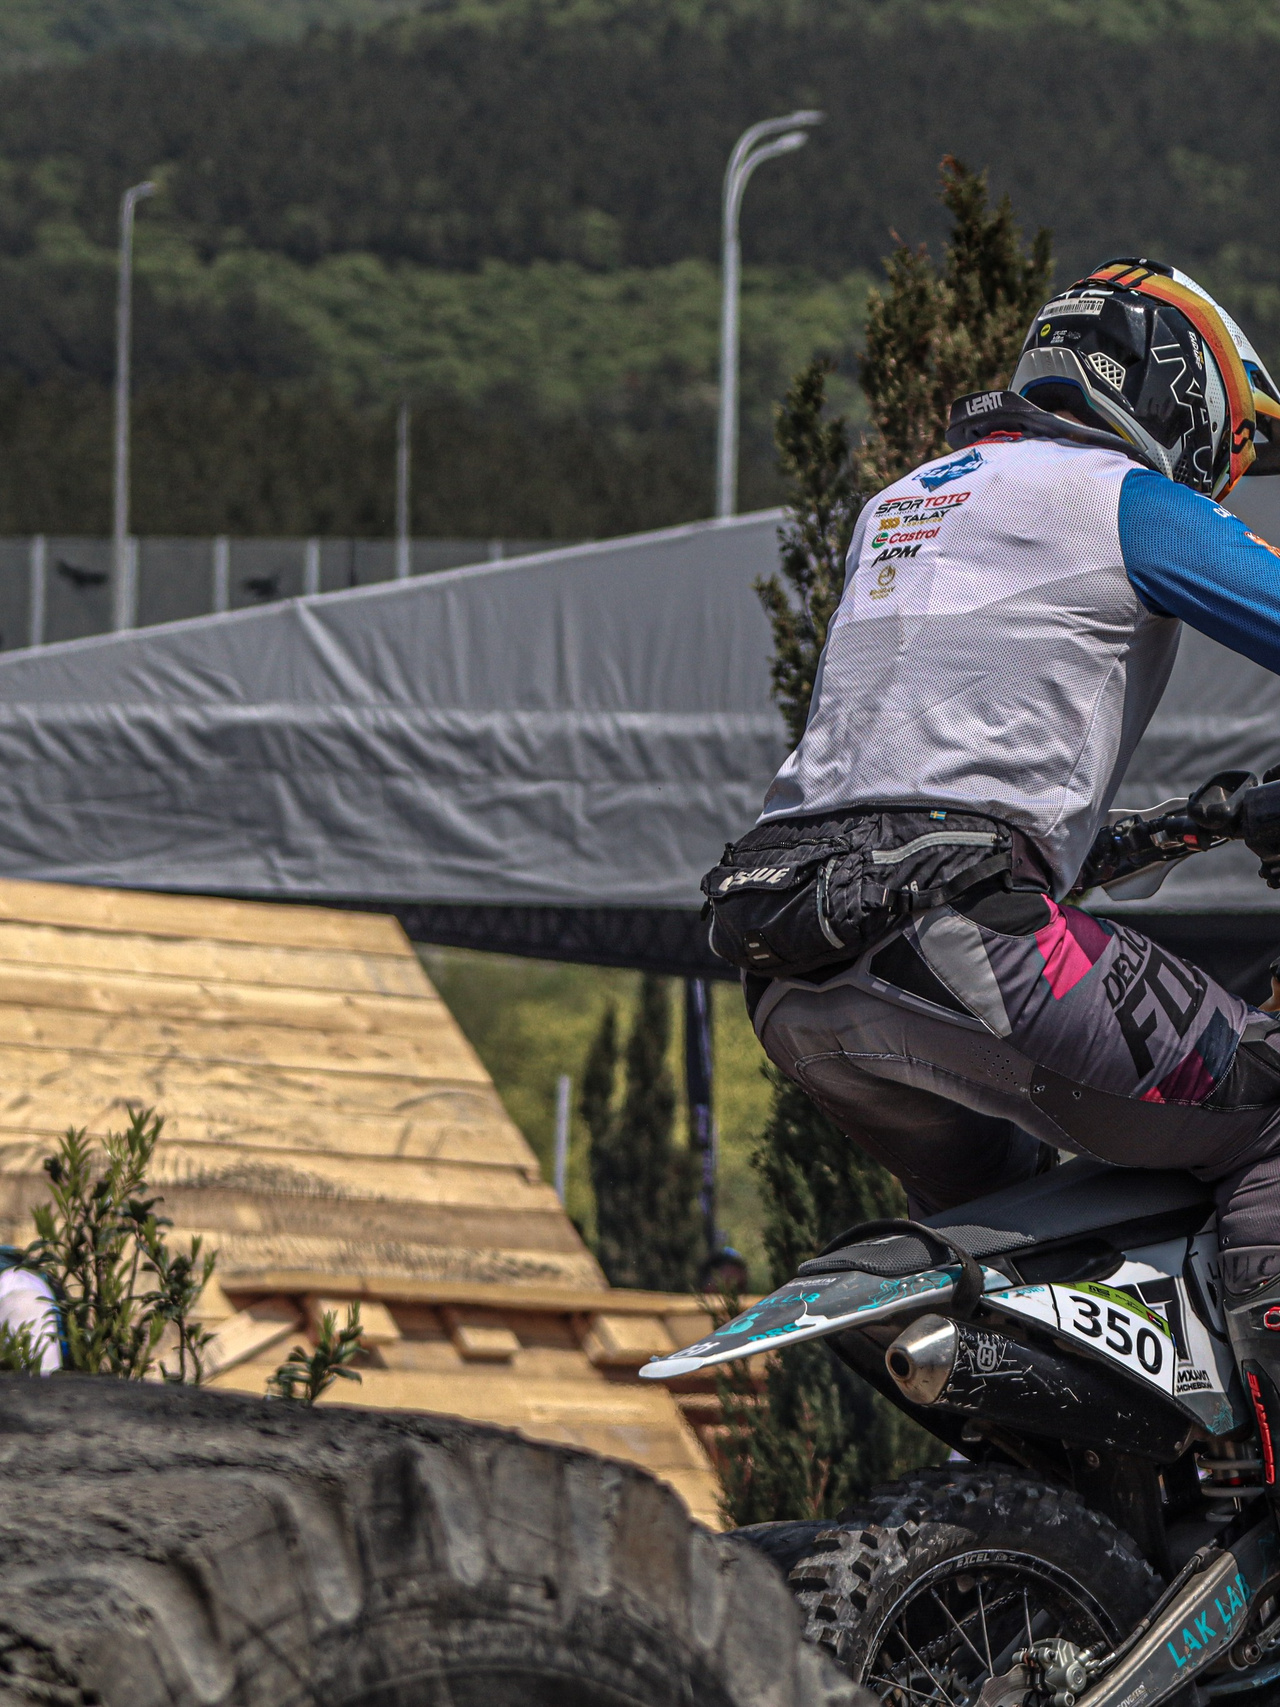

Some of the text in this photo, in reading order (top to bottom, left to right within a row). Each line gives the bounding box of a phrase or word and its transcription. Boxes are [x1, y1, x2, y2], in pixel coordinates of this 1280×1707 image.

[965, 391, 1004, 416] LEATT
[903, 509, 950, 523] TALAY
[889, 526, 942, 544] Castrol
[871, 544, 922, 568] ADM
[1069, 1295, 1163, 1375] 350
[956, 1552, 990, 1568] EXCEL
[1167, 1572, 1252, 1669] LAK LAB
